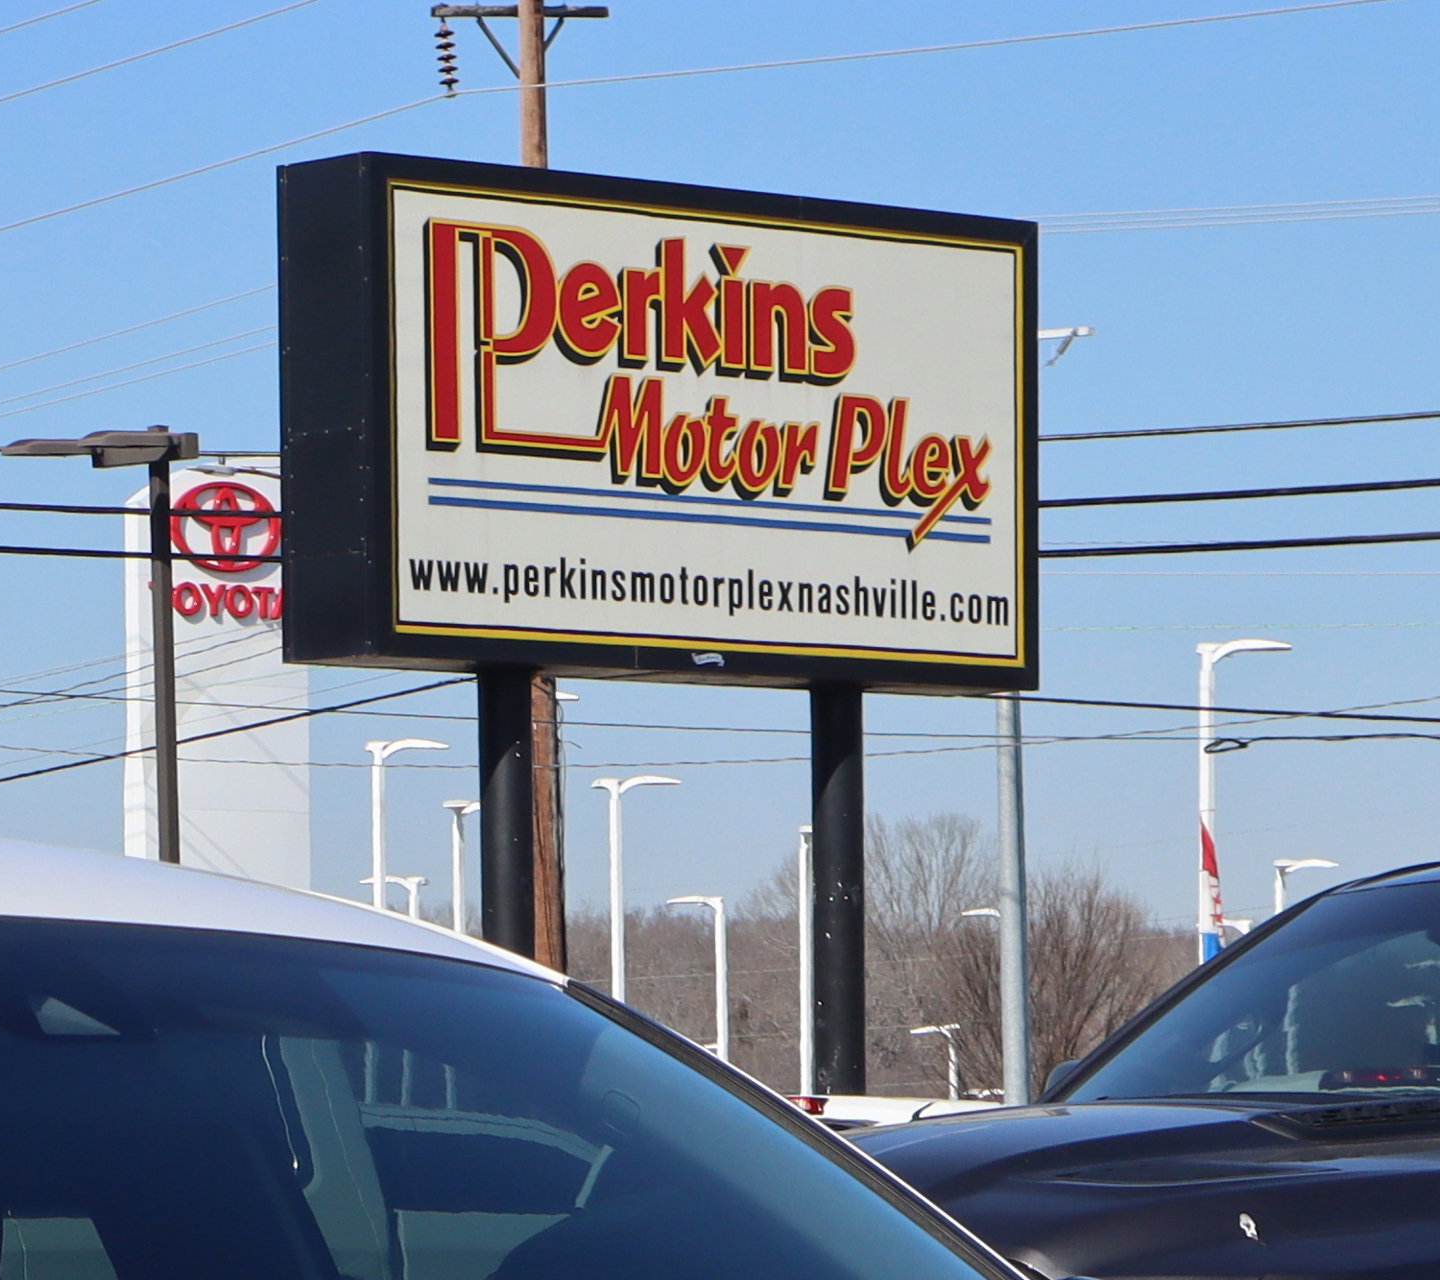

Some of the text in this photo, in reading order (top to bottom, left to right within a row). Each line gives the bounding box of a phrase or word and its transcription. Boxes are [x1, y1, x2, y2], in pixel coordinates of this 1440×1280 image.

[424, 217, 855, 450] Perkins
[602, 373, 993, 553] Motor Plex
[148, 581, 282, 620] OYOT
[409, 557, 1011, 626] www.perkinsmotorplexnashville.com
